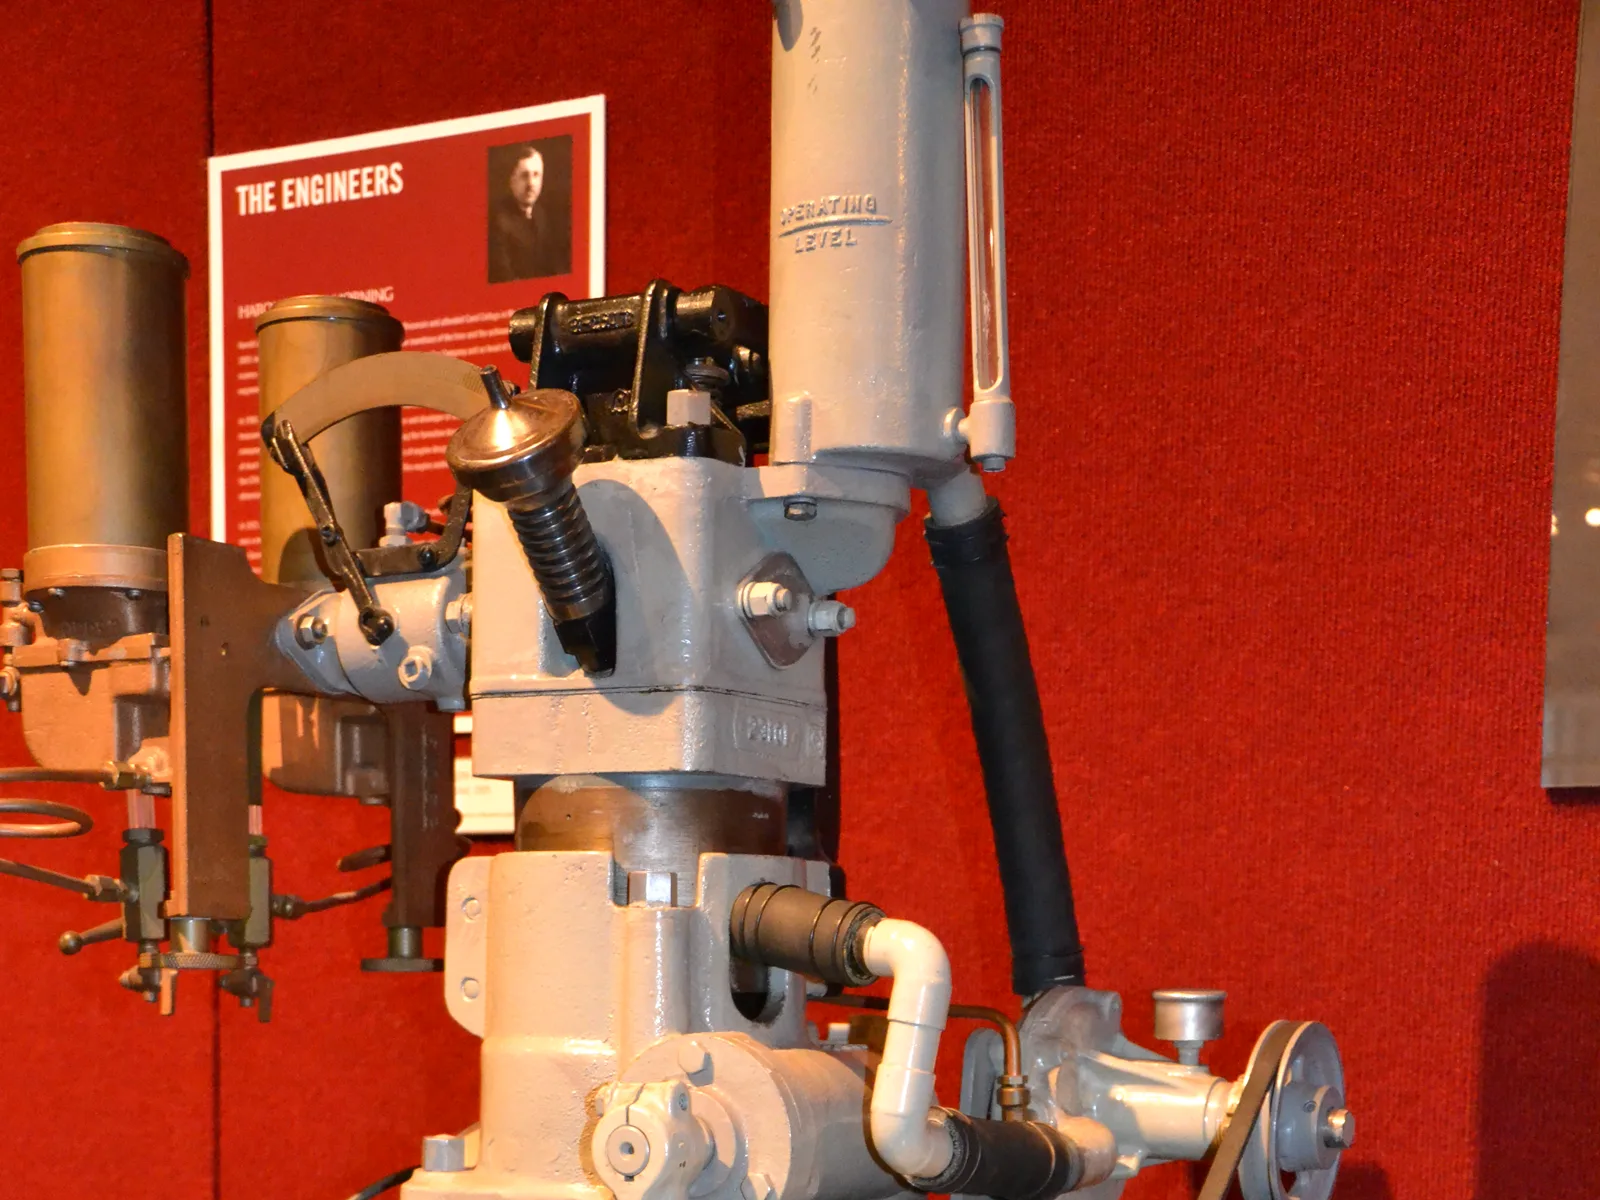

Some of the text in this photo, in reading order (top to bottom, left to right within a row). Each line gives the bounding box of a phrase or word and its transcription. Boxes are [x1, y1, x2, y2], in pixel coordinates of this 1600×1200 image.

[235, 162, 403, 216] THE ENGINEERS
[780, 194, 877, 226] OPERATING
[795, 227, 858, 253] LEVEL
